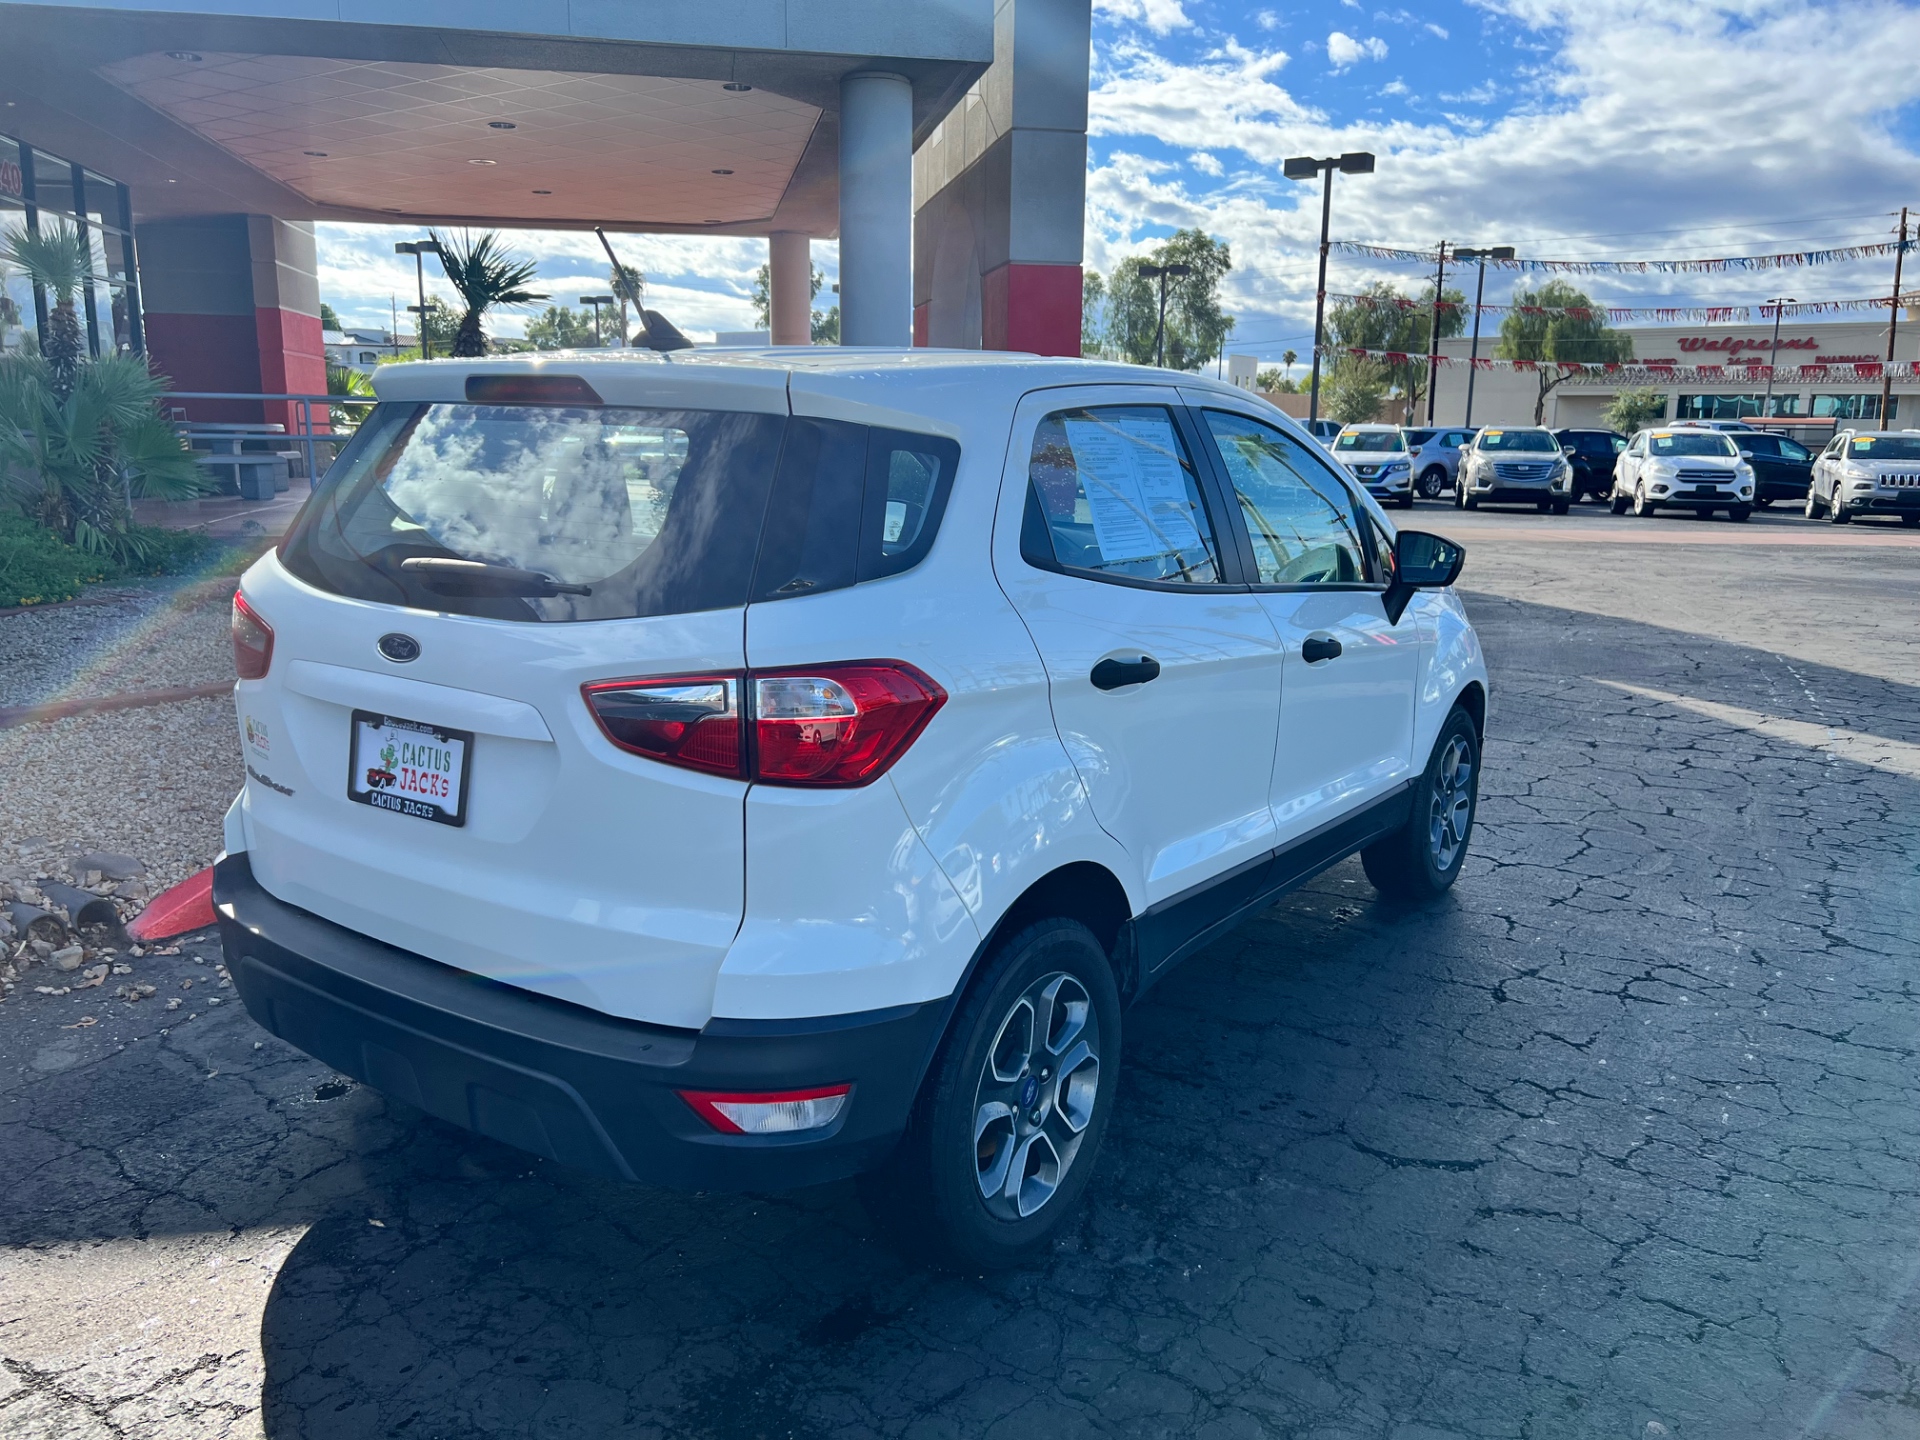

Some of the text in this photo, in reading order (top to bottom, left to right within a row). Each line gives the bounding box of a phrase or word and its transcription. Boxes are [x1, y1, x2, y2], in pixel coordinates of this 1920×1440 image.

[1678, 336, 1819, 356] Walgreens
[1815, 355, 1879, 364] PHARMACY
[402, 741, 451, 773] CACTUS
[371, 792, 402, 813] CACTUS
